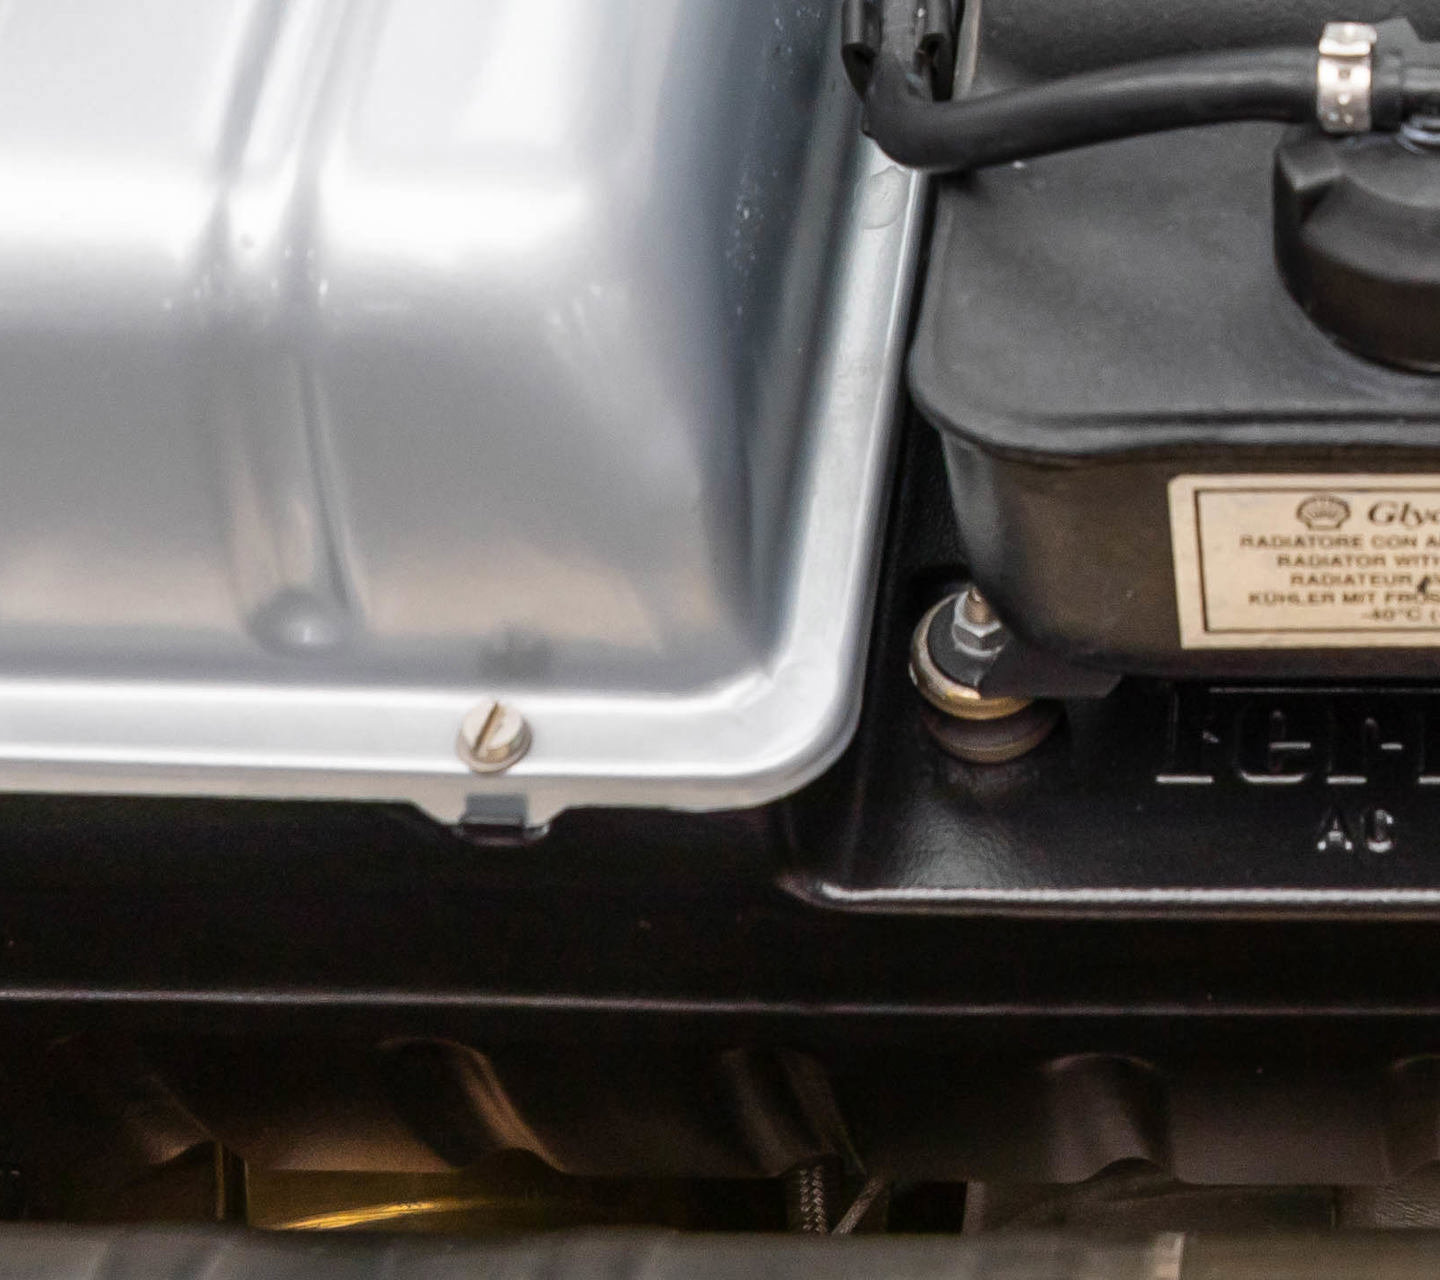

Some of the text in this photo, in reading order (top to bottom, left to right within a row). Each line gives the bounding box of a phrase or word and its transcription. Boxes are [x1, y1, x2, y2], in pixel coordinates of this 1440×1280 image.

[1239, 533, 1365, 548] RADIATORE
[1370, 533, 1419, 548] CON
[1276, 552, 1387, 568] RADIATOR
[1290, 572, 1413, 587] RADIATEUR
[1248, 590, 1336, 605] KÜHLER
[1343, 591, 1377, 605] MIT
